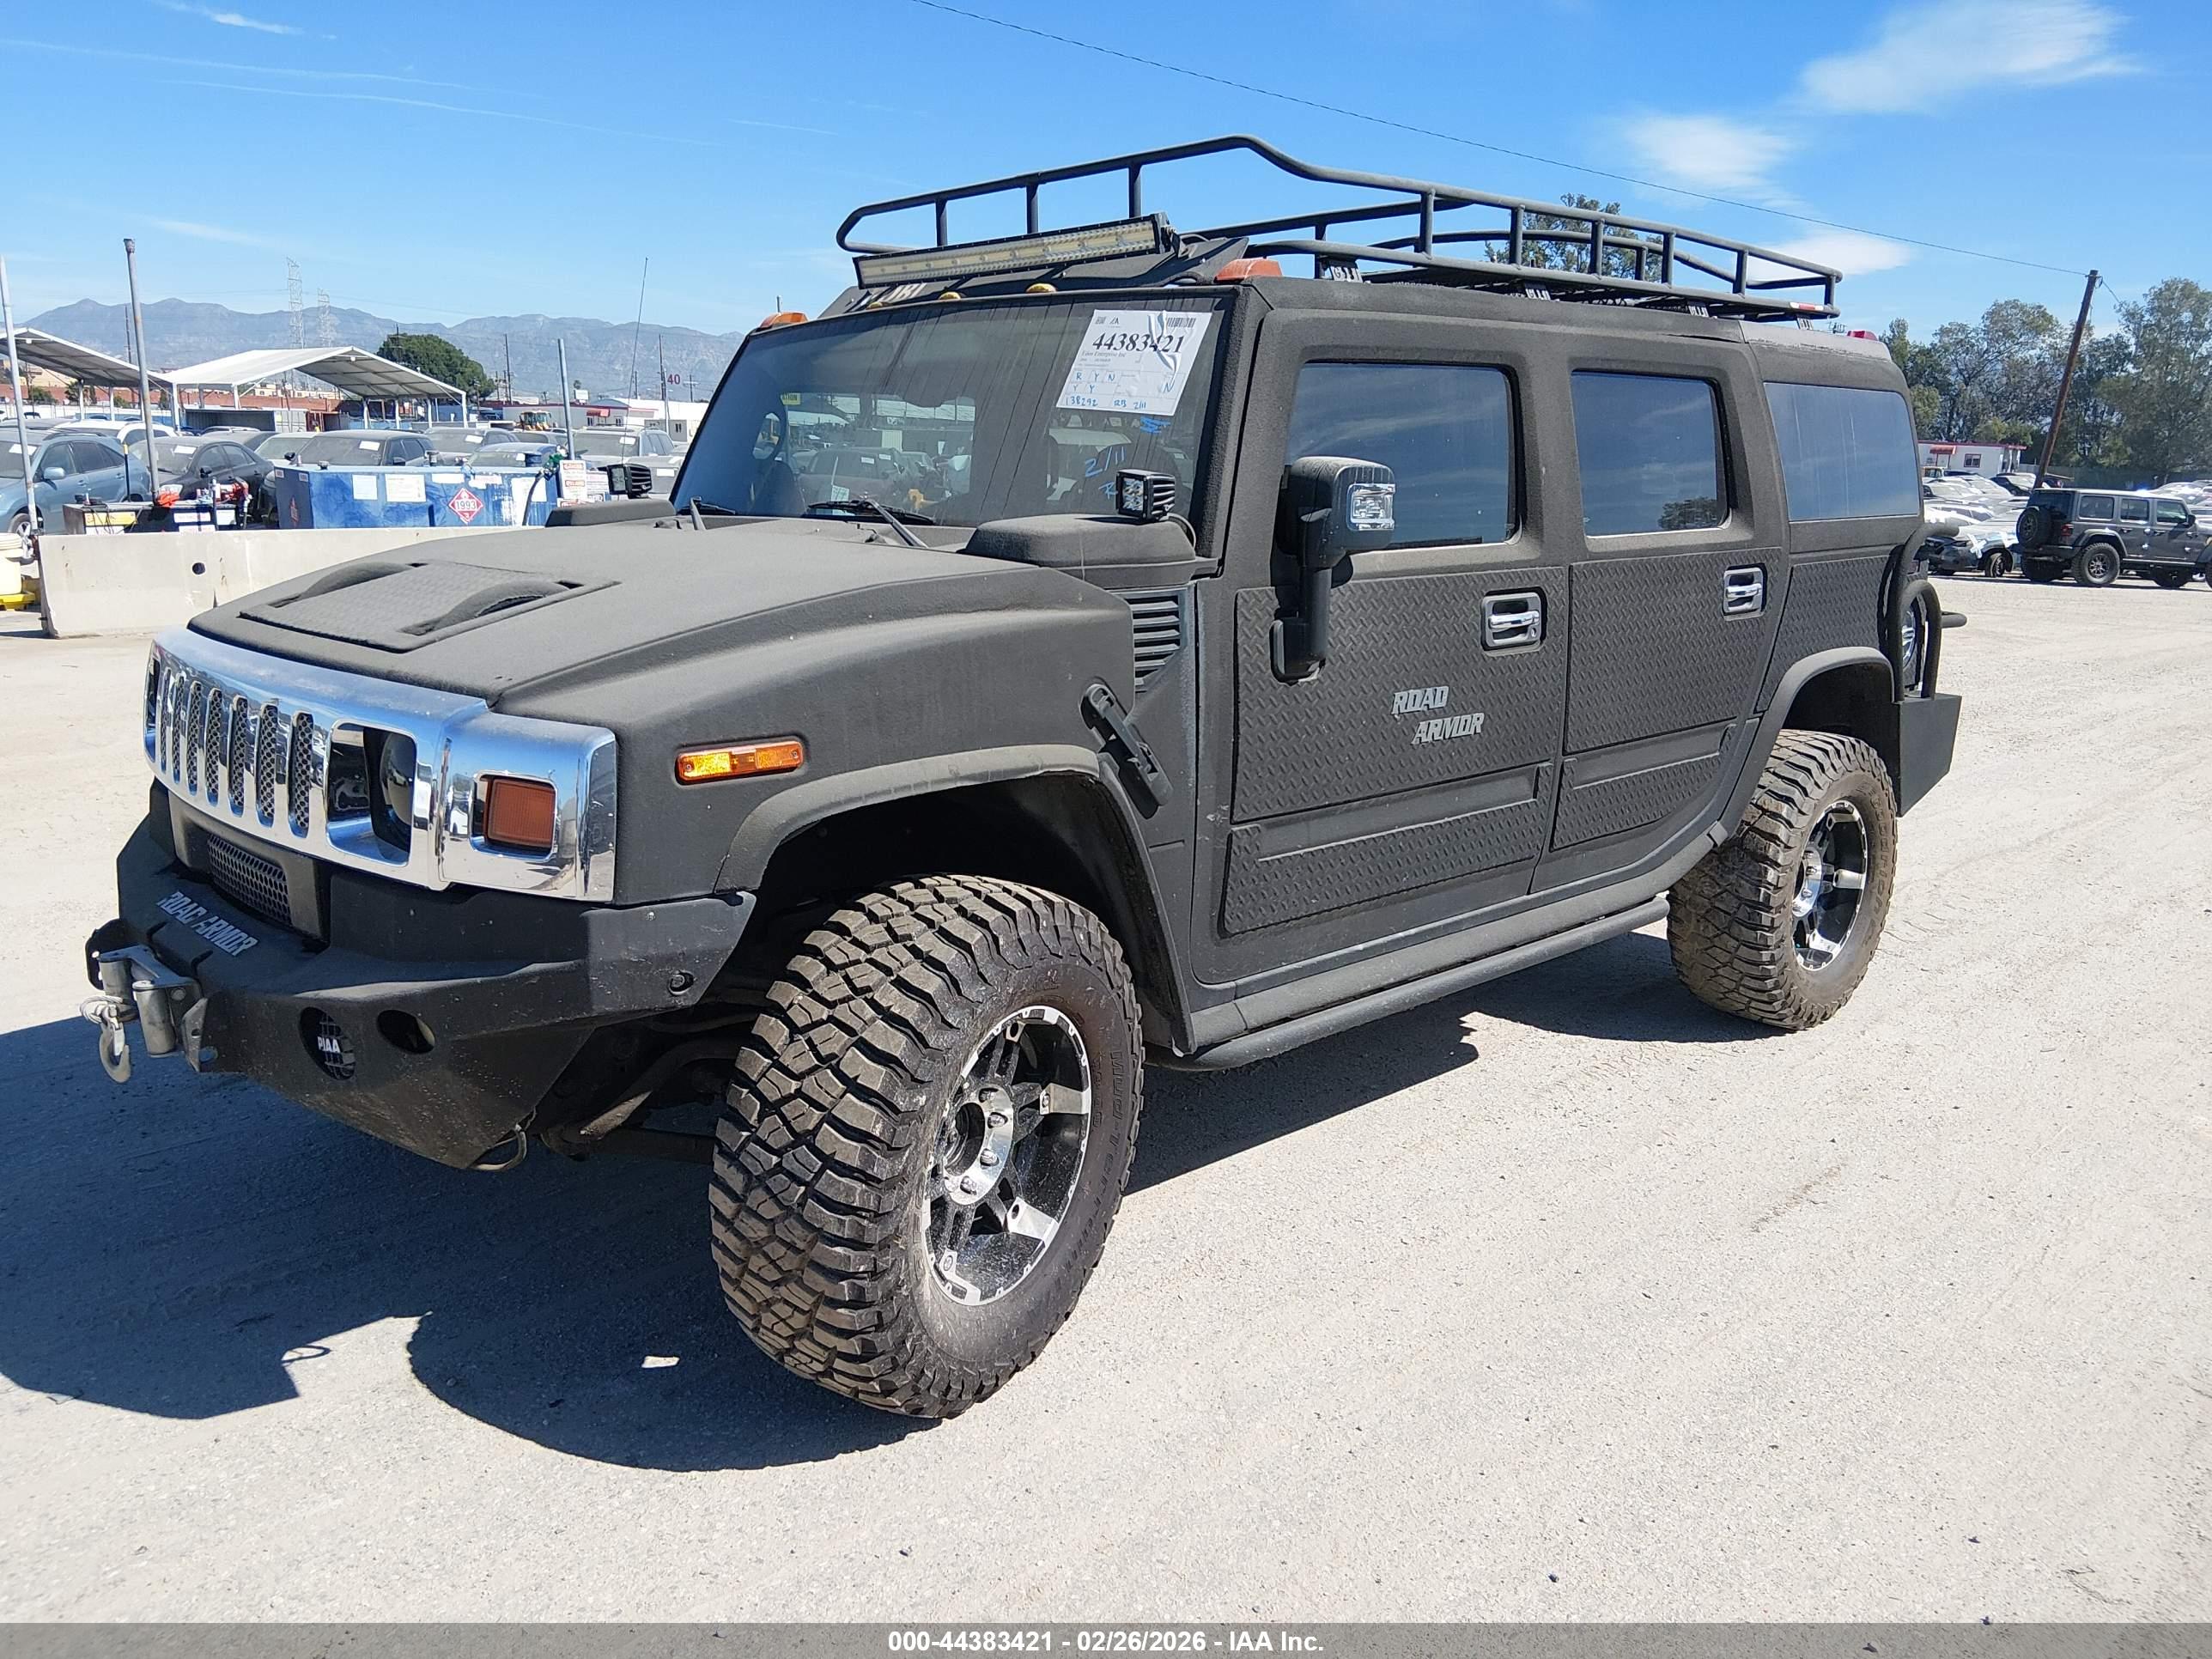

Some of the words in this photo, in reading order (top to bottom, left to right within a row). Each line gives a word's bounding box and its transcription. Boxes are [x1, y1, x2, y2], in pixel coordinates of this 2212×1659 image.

[1092, 332, 1185, 353] 44383421
[667, 374, 681, 385] 40
[456, 501, 476, 509] 1993
[1391, 686, 1449, 714] ROAD
[1411, 713, 1485, 744] ARMOR
[155, 890, 208, 925] ROAD
[191, 915, 258, 957] ARMOR
[317, 1036, 341, 1054] PIAA
